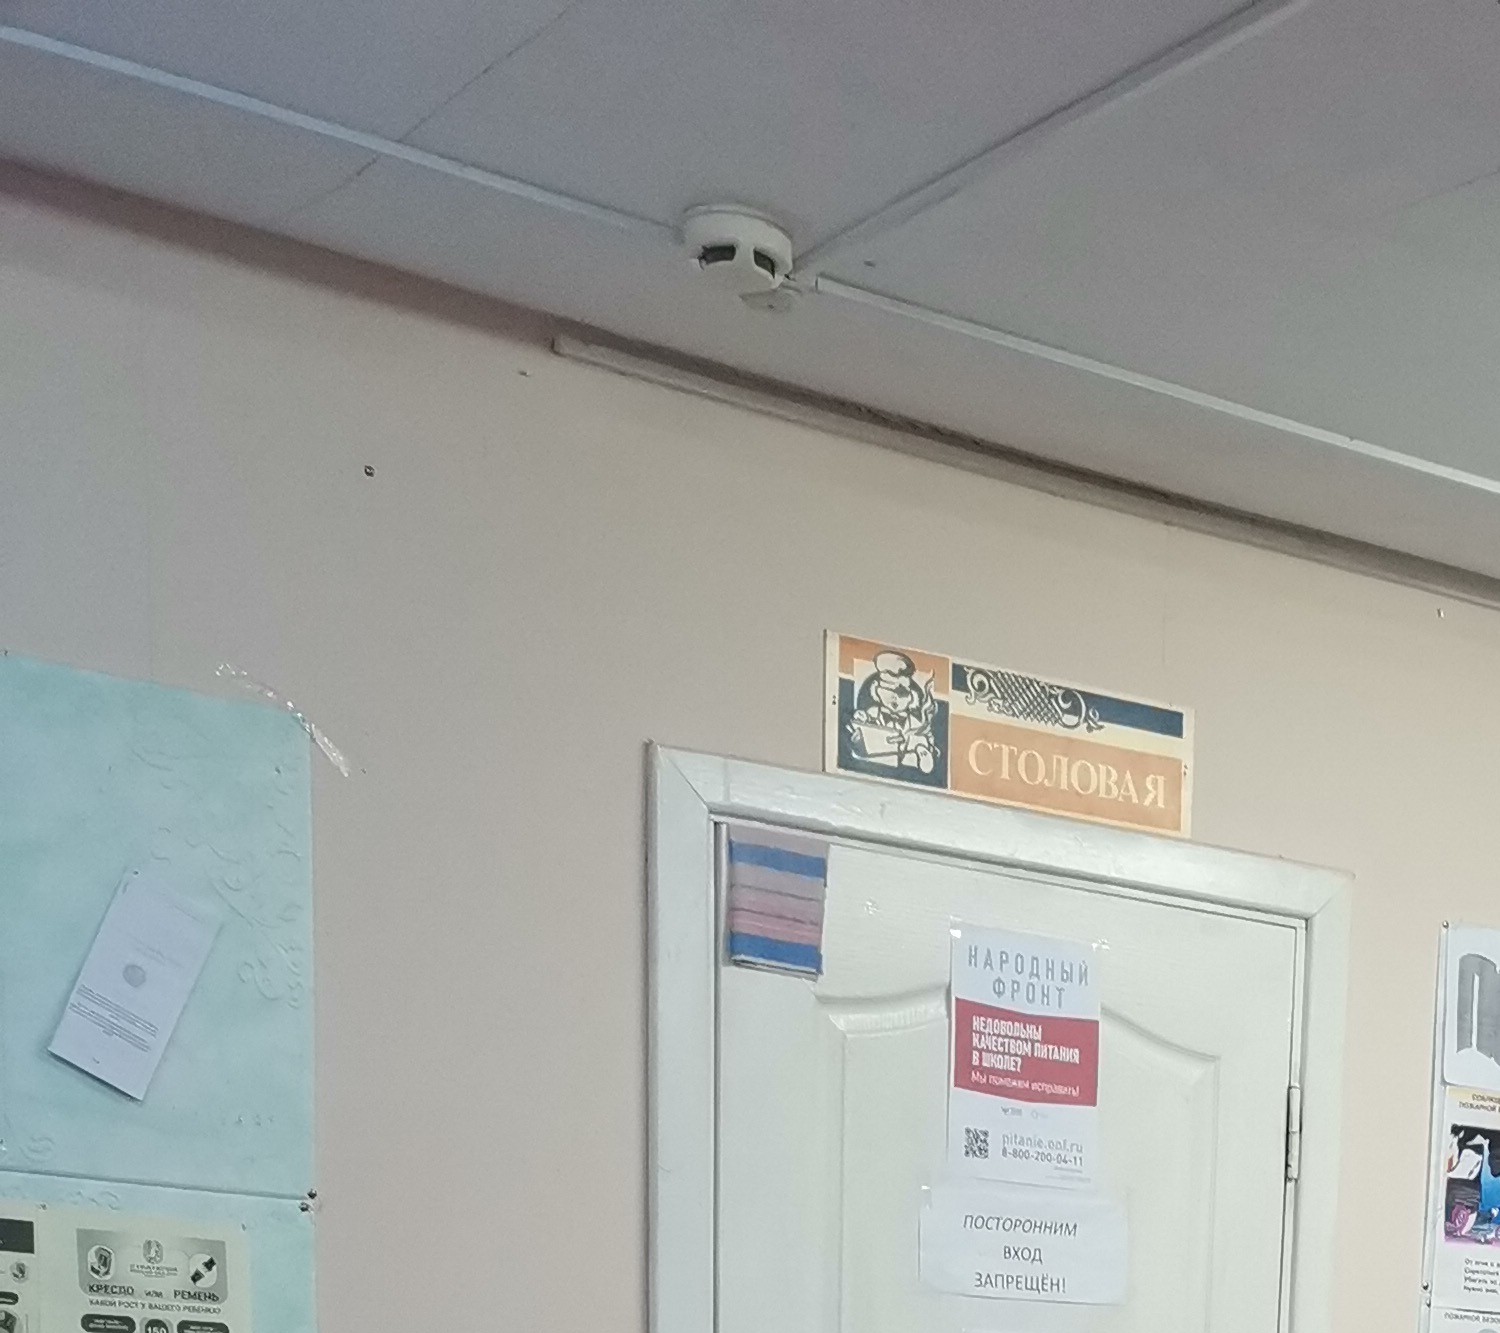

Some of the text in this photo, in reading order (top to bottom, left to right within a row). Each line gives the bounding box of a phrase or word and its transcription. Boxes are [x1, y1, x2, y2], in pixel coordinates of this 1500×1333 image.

[968, 738, 1166, 809] СТОЛОВАЯ
[967, 944, 1090, 987] НАРОДНЫЙ
[992, 976, 1066, 1009] ФРОНТ
[972, 1015, 1043, 1040] НЕДОВОЛЬНЫ
[972, 1035, 1080, 1064] КАЧЕСТВОМ ПИТАНИЯ
[971, 1050, 1022, 1073] В ШКОЛЕ?
[970, 1070, 987, 1085] Мы
[1001, 1147, 1083, 1166] 8-800-200-04-11
[963, 1214, 1078, 1238] ПОСТОРОННИМ
[1003, 1245, 1043, 1265] ВХОД
[89, 1283, 135, 1296] КРЕСЛО
[173, 1289, 220, 1303] РЕМЕНЬ
[974, 1271, 1066, 1294] ЗАПРЕЩЁН!
